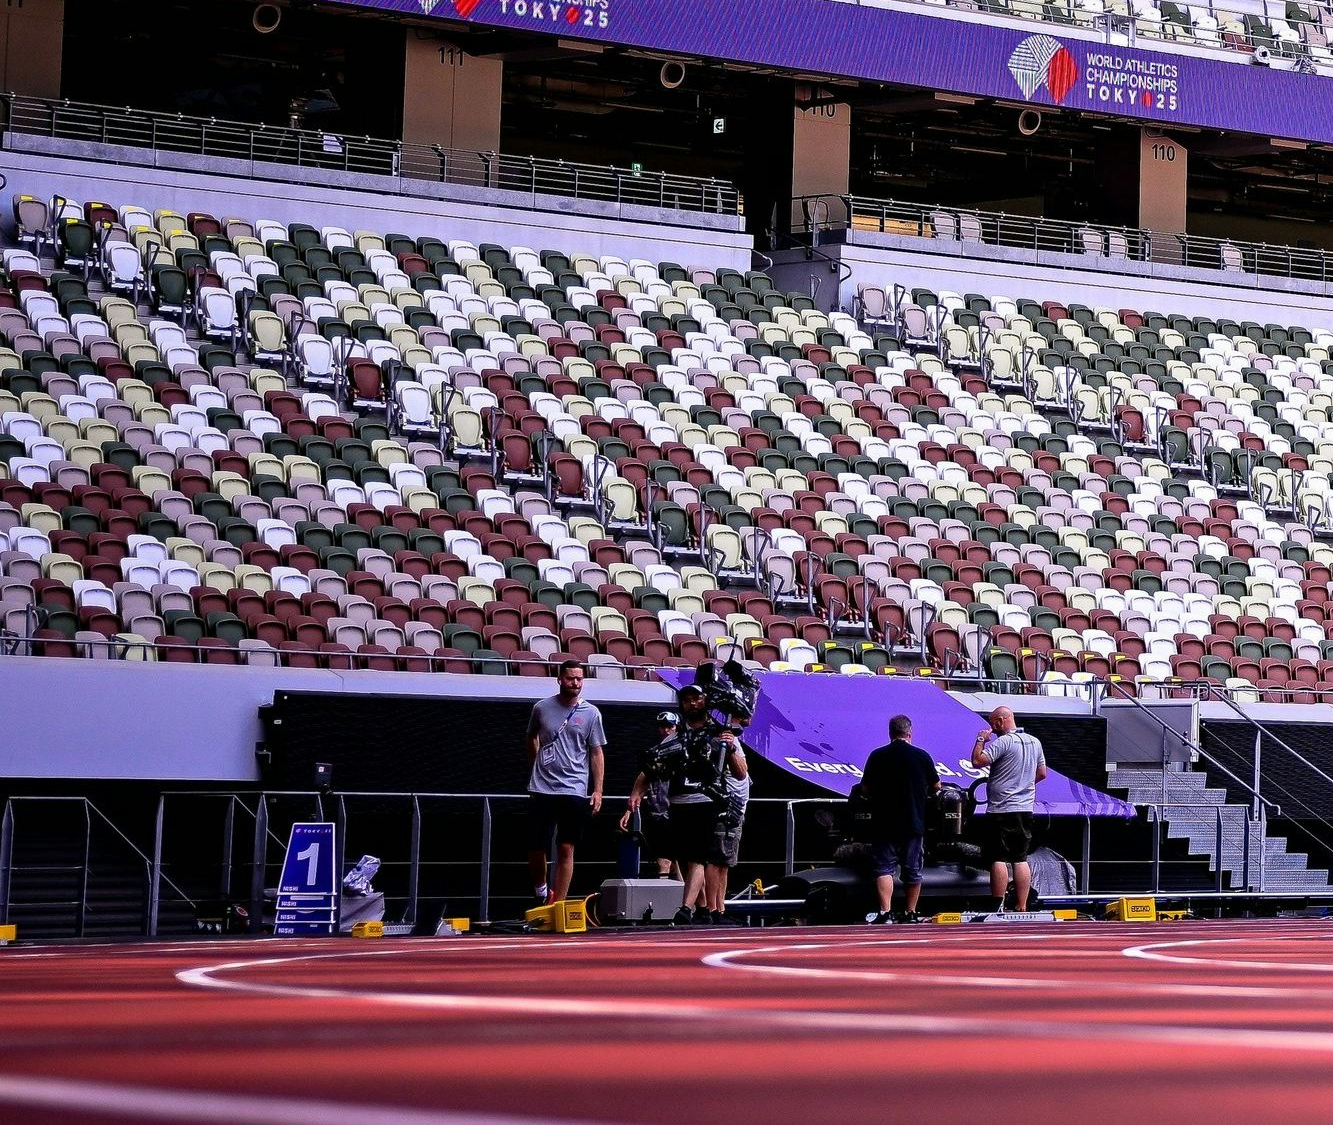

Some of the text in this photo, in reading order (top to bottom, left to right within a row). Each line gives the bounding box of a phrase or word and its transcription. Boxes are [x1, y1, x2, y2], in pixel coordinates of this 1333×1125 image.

[438, 46, 463, 66] 111
[1086, 53, 1177, 77] WORLD ATHLETICS
[1086, 69, 1177, 93] CHAMPIONSHIPS
[1086, 84, 1177, 110] TOKYO25
[1151, 144, 1175, 161] 110
[784, 756, 864, 778] Every
[297, 843, 319, 885] 1
